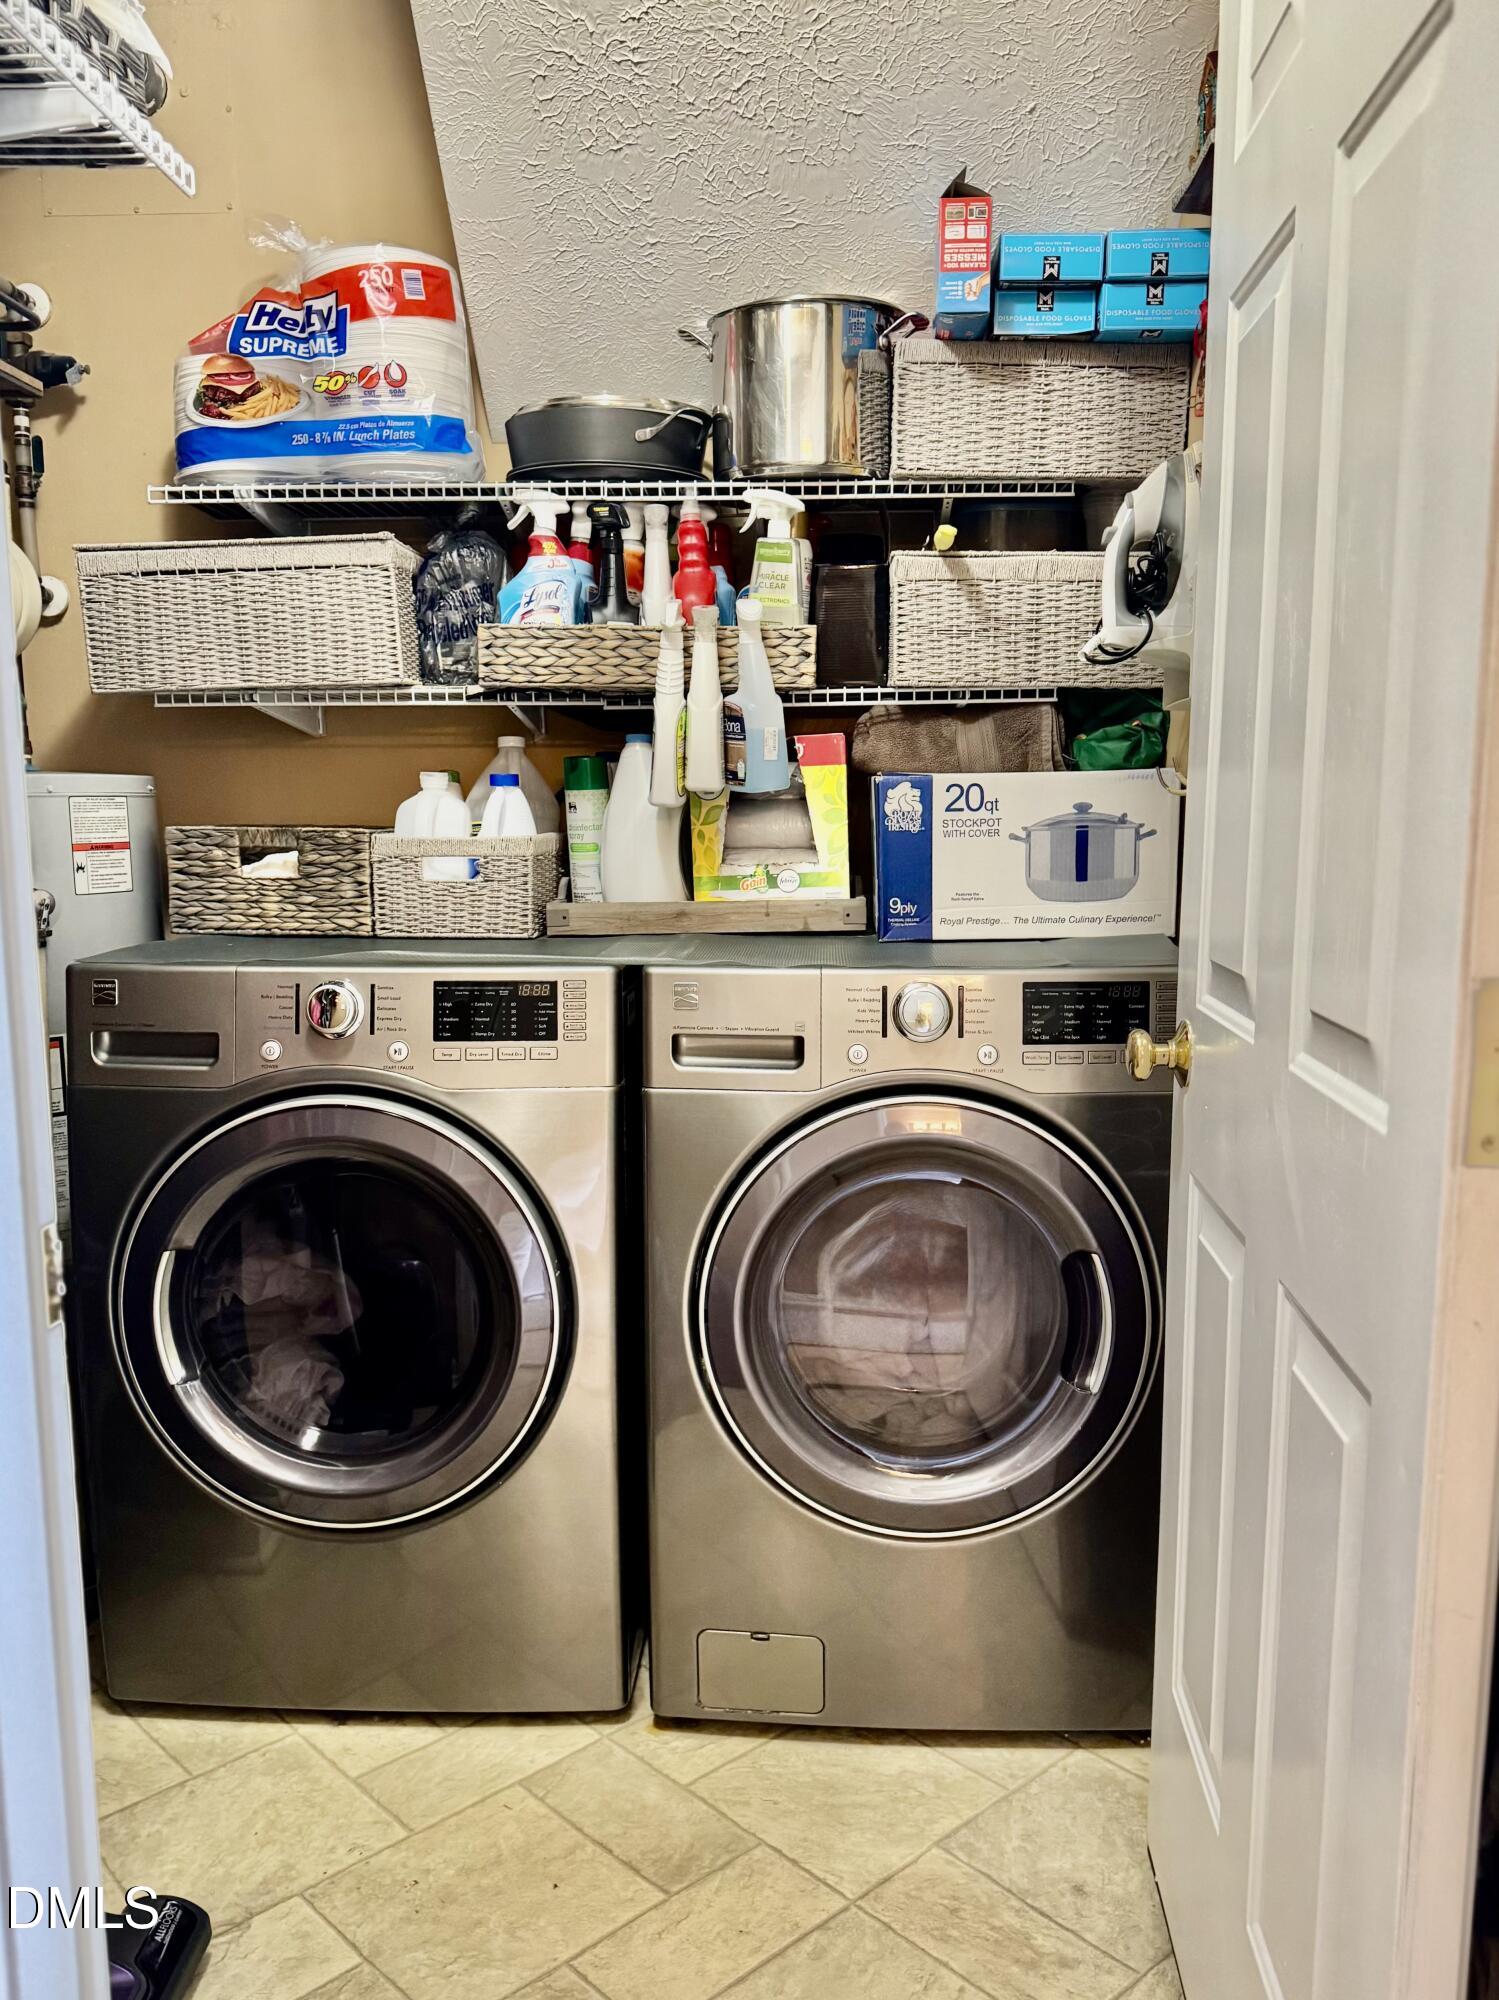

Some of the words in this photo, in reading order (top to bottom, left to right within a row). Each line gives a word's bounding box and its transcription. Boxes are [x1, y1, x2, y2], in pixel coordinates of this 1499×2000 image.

[944, 253, 986, 262] MESSES
[358, 265, 394, 288] 250
[239, 336, 339, 357] SUPREME
[312, 372, 357, 393] 50%
[292, 434, 308, 445] 250
[333, 432, 346, 442] IN.
[349, 428, 379, 441] Lunch
[383, 428, 415, 440] Plates
[758, 573, 790, 581] MIRACLE
[524, 584, 562, 608] Lysol
[944, 783, 1000, 815] 20qt
[942, 818, 1002, 828] STOCKPOT
[968, 829, 1001, 838] COVER
[741, 877, 767, 891] Gain
[889, 897, 918, 916] 9ply
[940, 917, 964, 927] Royal
[966, 917, 1009, 926] Prestige...
[1031, 916, 1066, 924] Ultimate
[1068, 915, 1103, 925] Culinary
